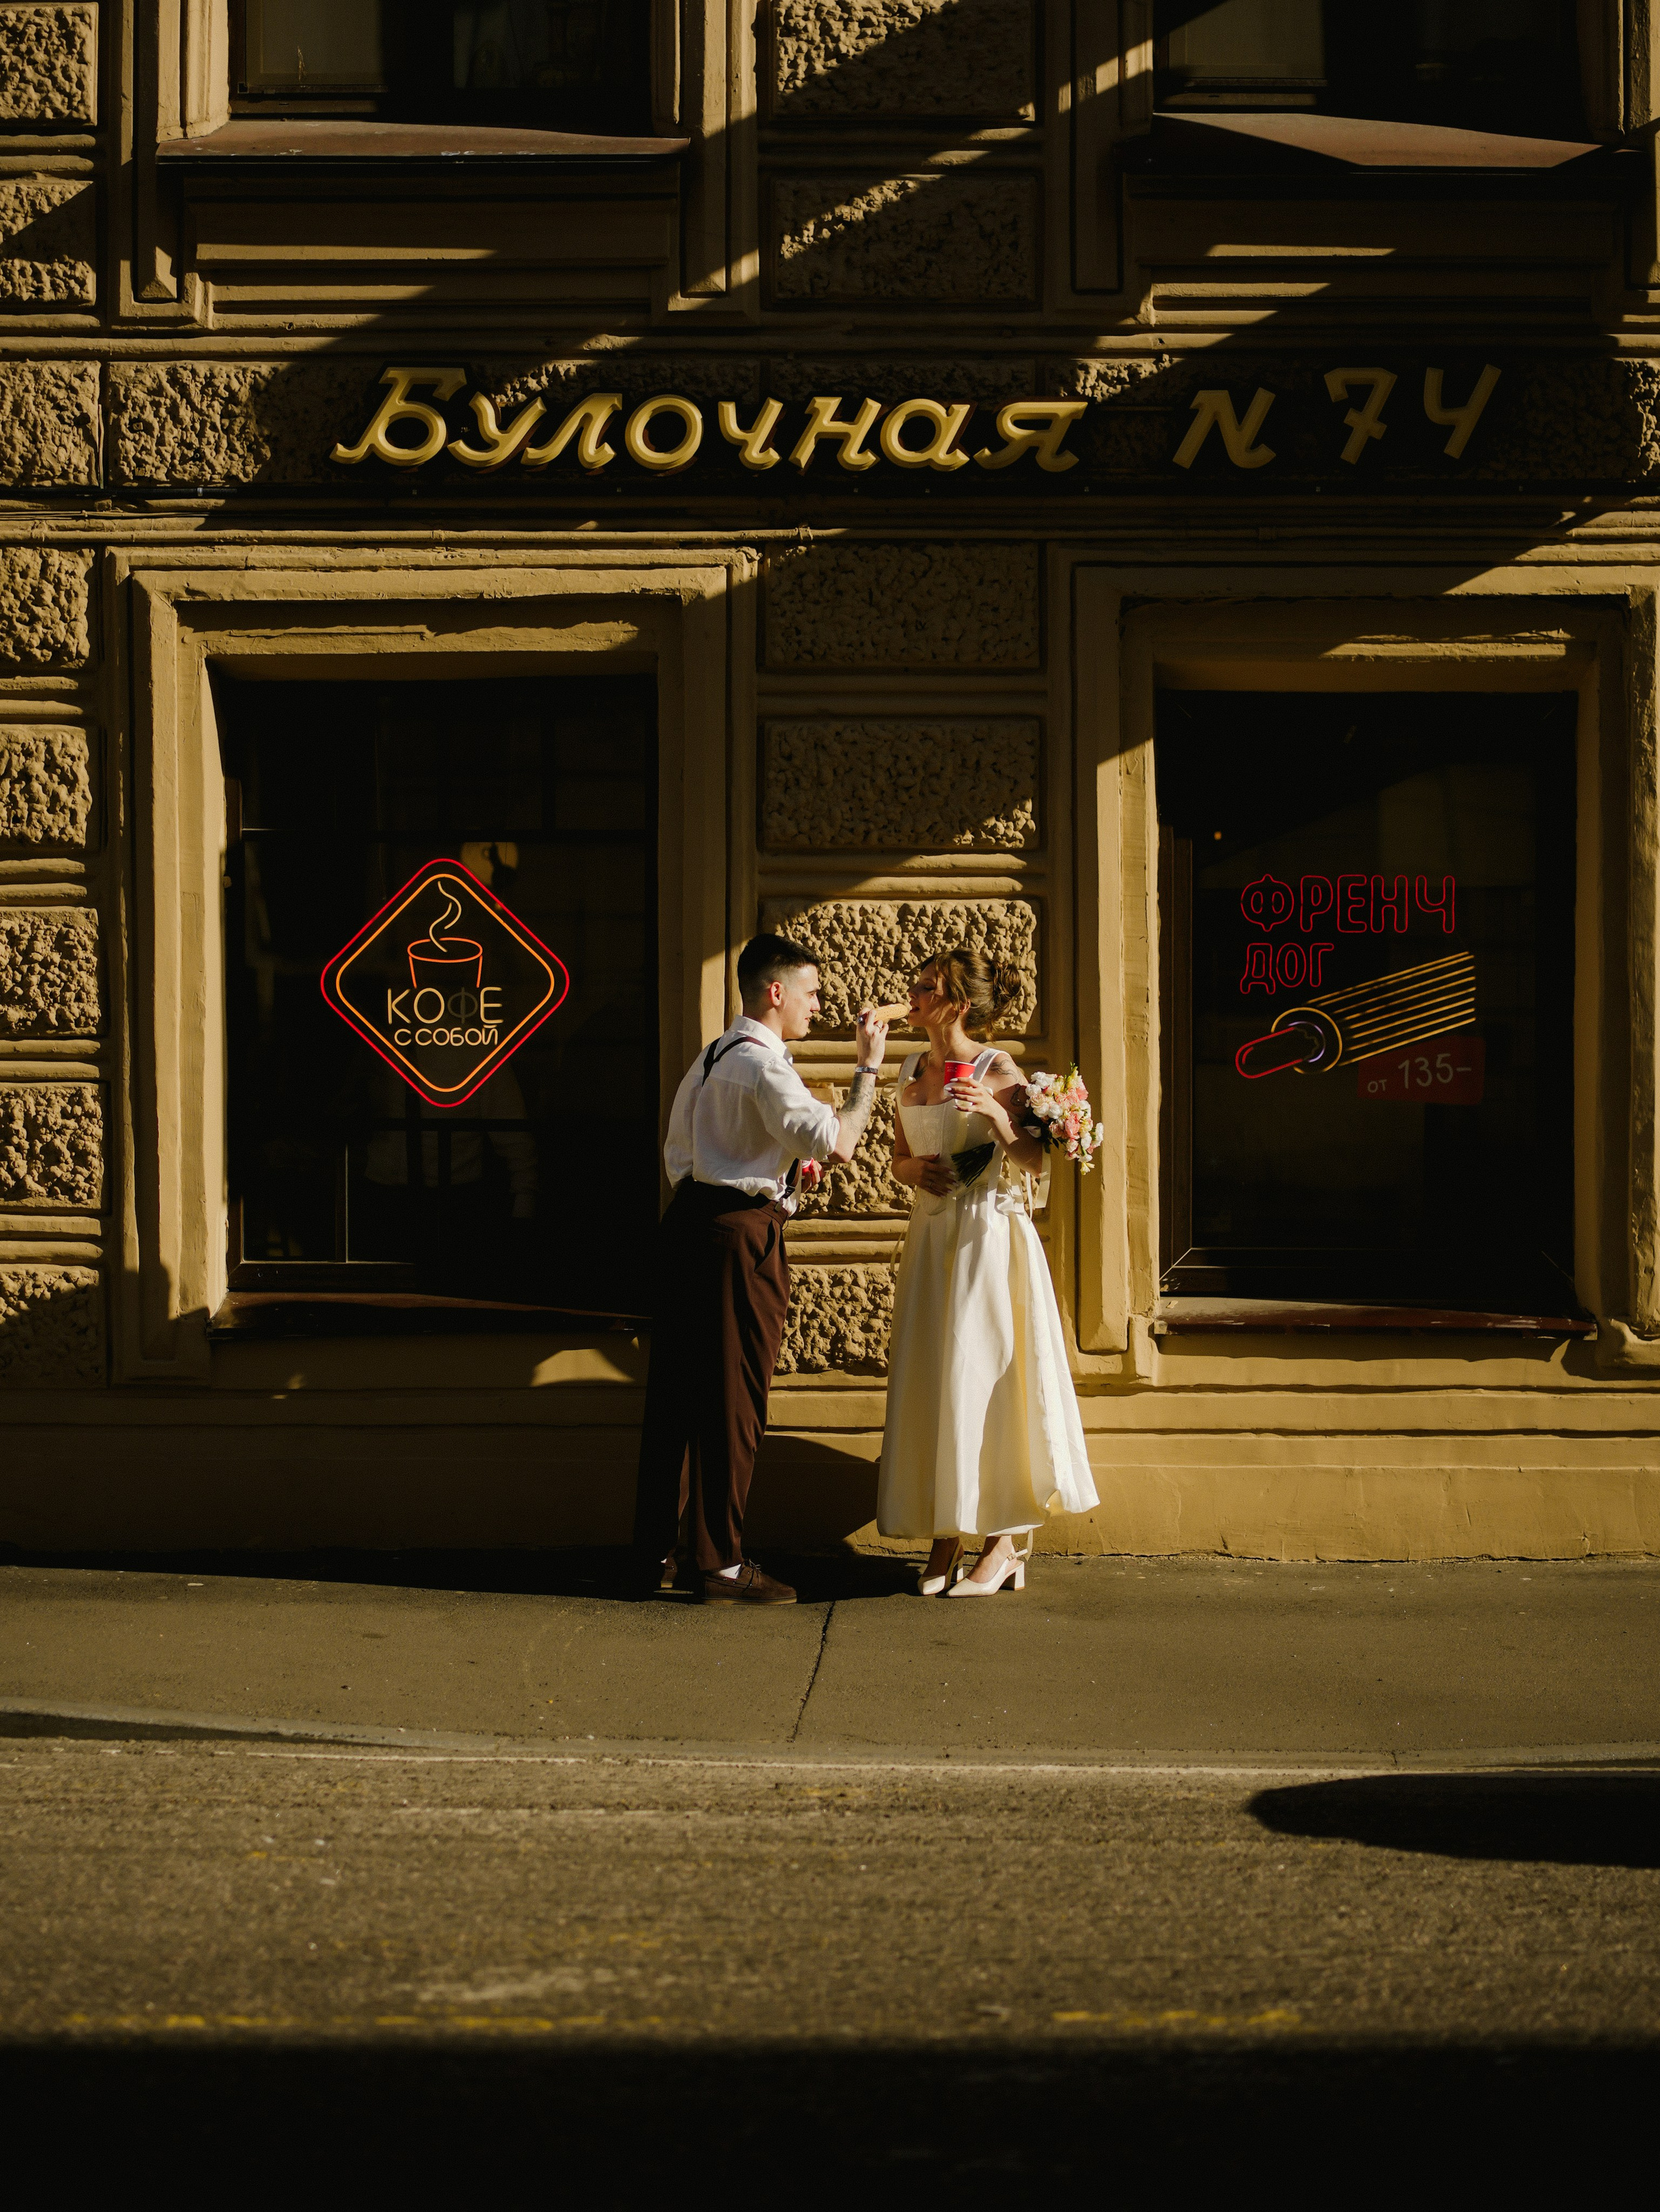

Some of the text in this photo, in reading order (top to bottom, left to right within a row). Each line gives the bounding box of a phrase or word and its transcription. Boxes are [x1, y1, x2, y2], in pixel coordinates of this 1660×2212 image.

[329, 367, 1088, 473] Булочная
[1240, 874, 1455, 933] ФРЕНЧ
[1240, 942, 1334, 994] ДОГ
[387, 987, 504, 1025] КОФЕ
